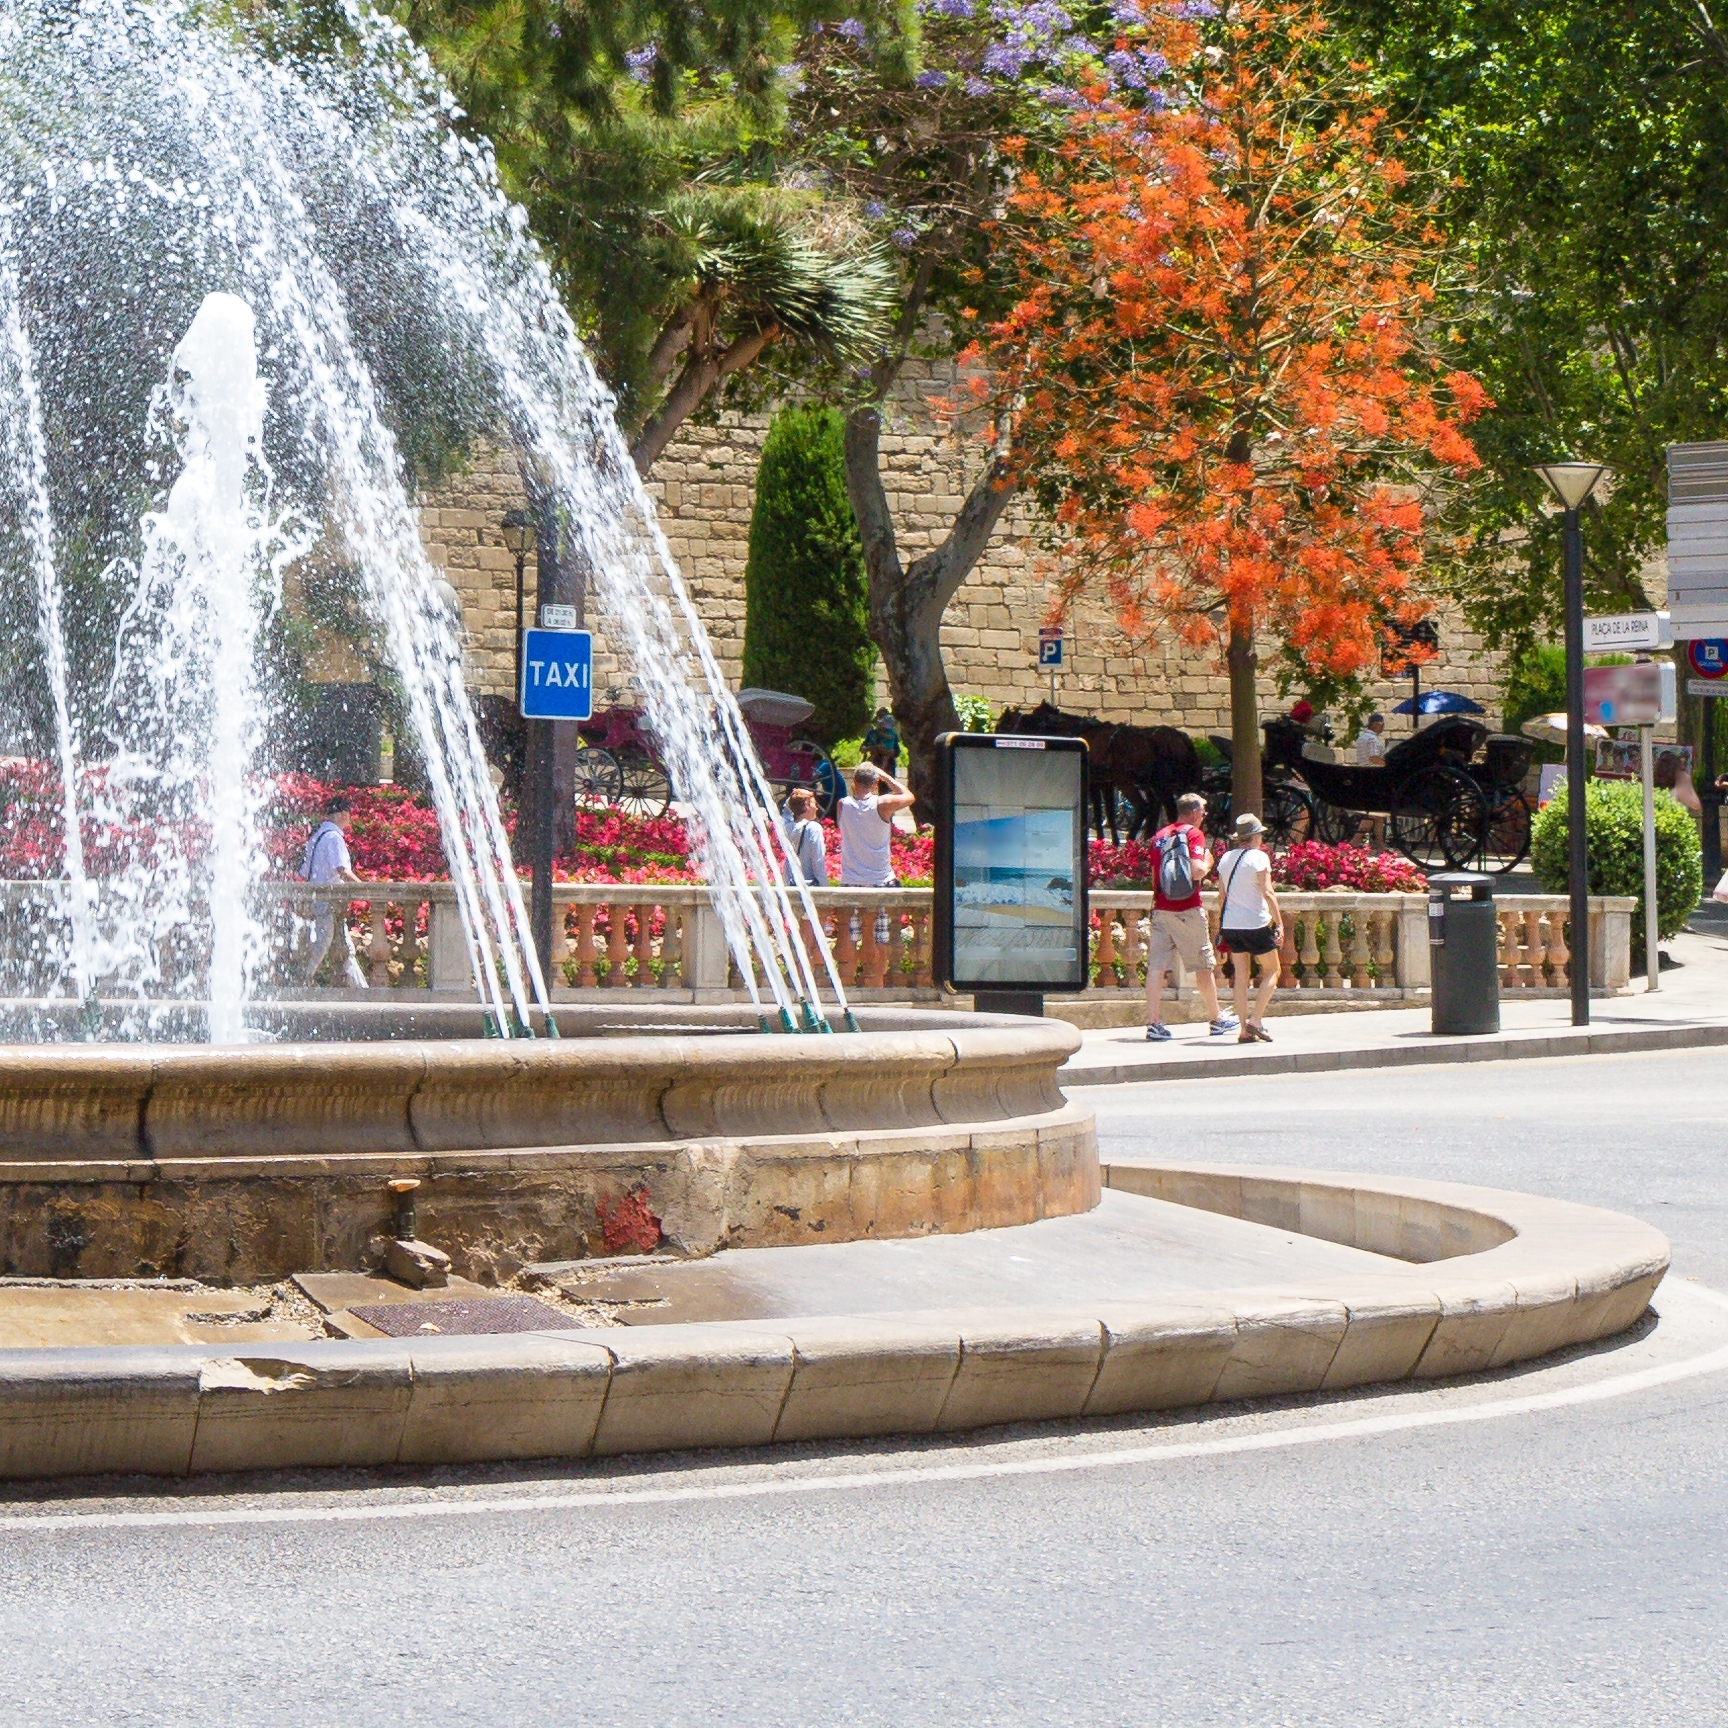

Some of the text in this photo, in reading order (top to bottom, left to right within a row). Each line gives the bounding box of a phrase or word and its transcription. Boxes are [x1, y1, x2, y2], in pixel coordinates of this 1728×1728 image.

[1591, 619, 1649, 638] PLAÇA DE LA REINA
[1043, 643, 1057, 661] P
[1708, 648, 1715, 657] P
[529, 660, 588, 688] TAXI
